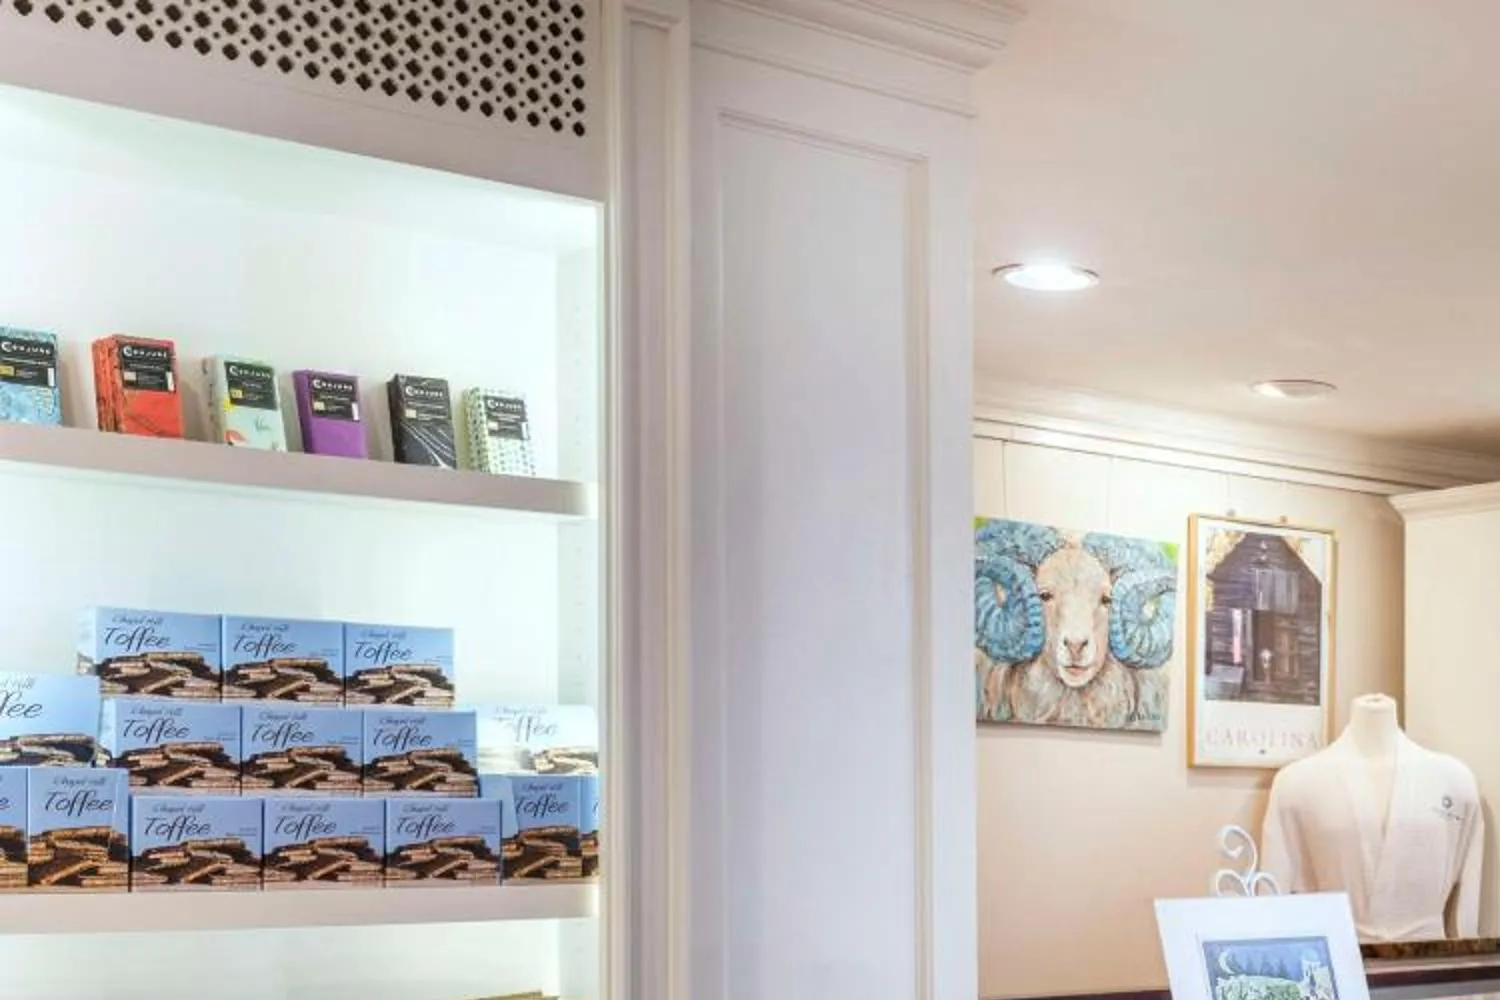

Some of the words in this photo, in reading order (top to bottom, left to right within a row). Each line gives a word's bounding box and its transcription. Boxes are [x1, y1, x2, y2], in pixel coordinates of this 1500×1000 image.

[103, 627, 170, 651] Toffee
[233, 633, 297, 659] Toffee
[355, 638, 413, 664] Toffee
[0, 690, 43, 719] fee
[123, 717, 190, 744] Toffee
[251, 722, 314, 748] Toffee
[373, 726, 432, 750] Toffee
[1206, 727, 1322, 749] CAROLINA
[44, 789, 112, 817] Toffee
[515, 794, 569, 818] Toffee
[143, 815, 212, 841] Toffee
[274, 814, 338, 841] Toffee
[396, 815, 456, 840] Toffee
